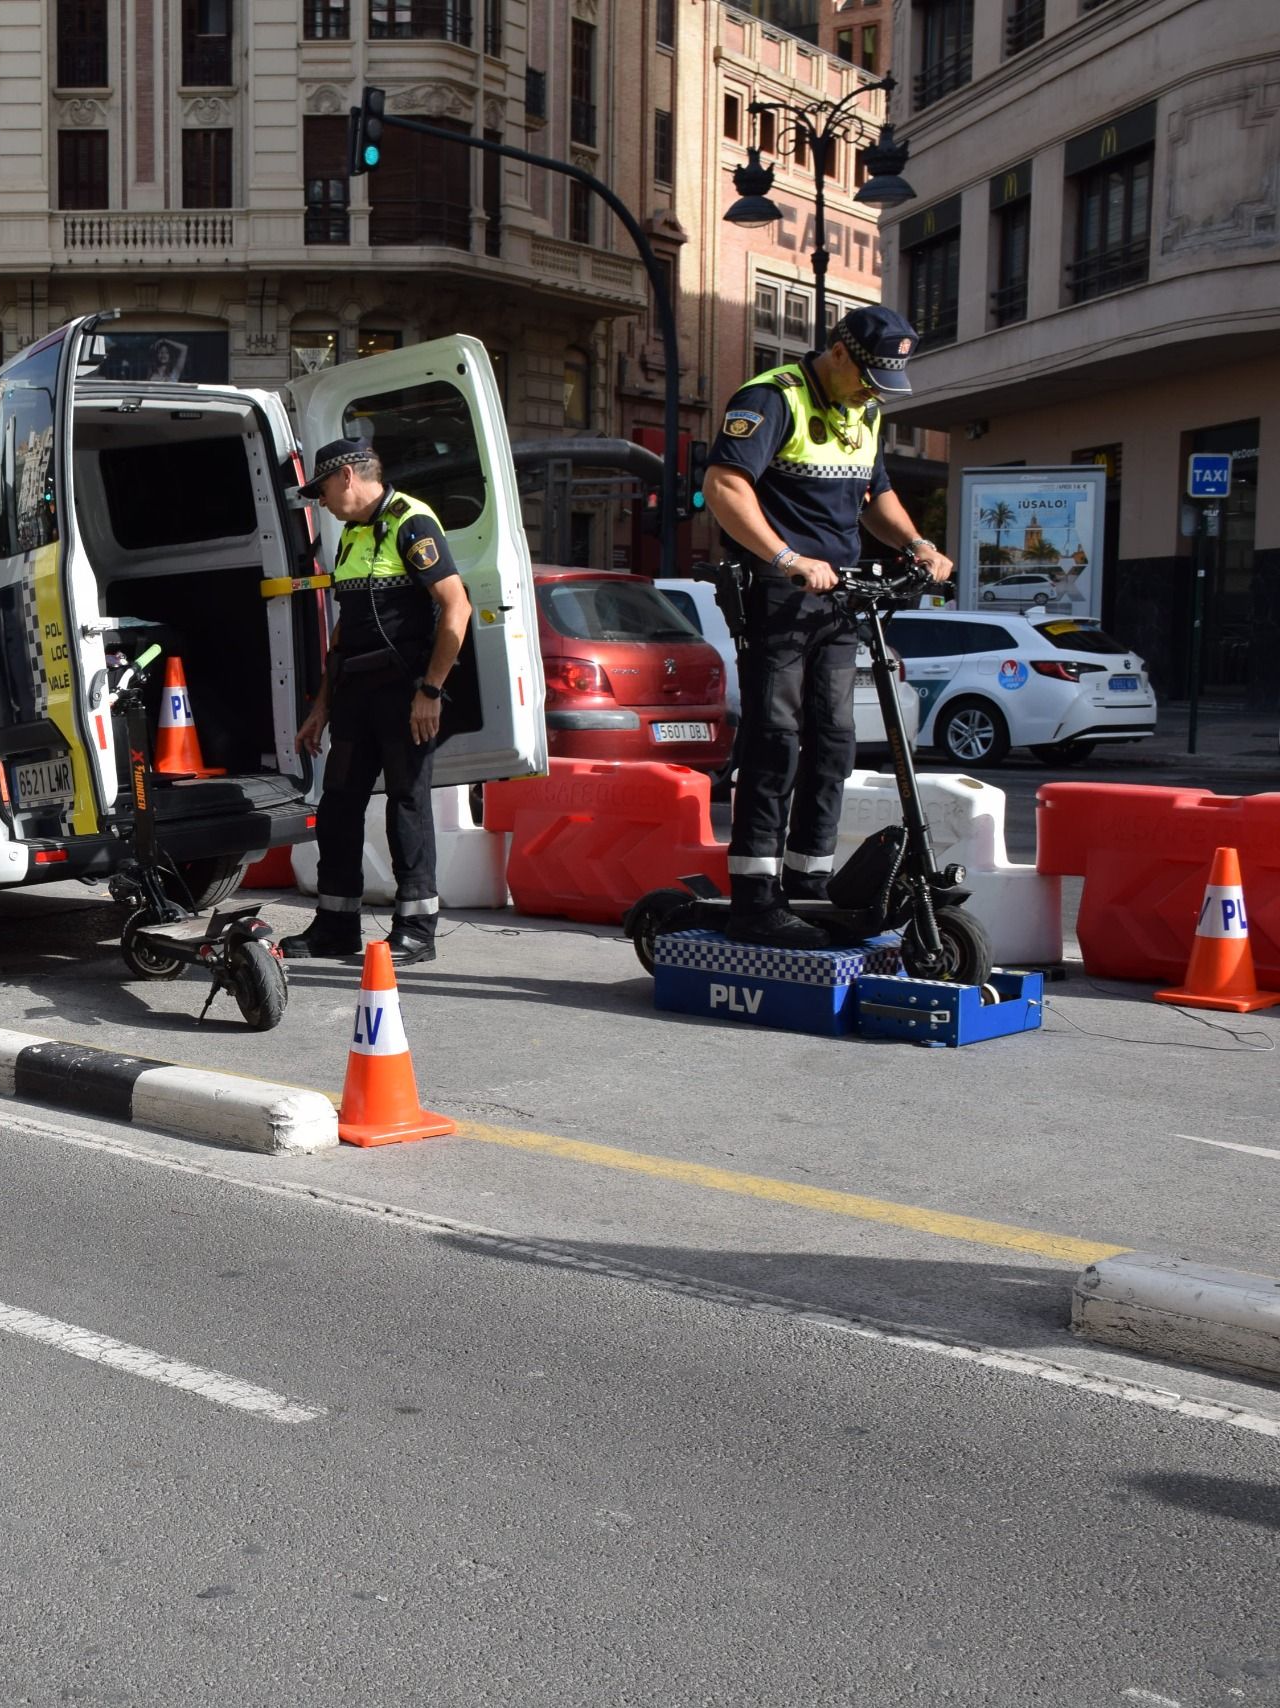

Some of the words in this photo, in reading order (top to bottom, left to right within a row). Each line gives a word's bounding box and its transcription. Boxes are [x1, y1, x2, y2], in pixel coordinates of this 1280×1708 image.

[1194, 469, 1228, 482] TAXI
[45, 623, 62, 639] POL
[51, 644, 68, 661] LOC
[660, 725, 686, 739] 5601
[689, 725, 707, 739] DBJ
[19, 769, 46, 797] 6521
[47, 763, 71, 793] LMR
[710, 983, 763, 1014] PLV
